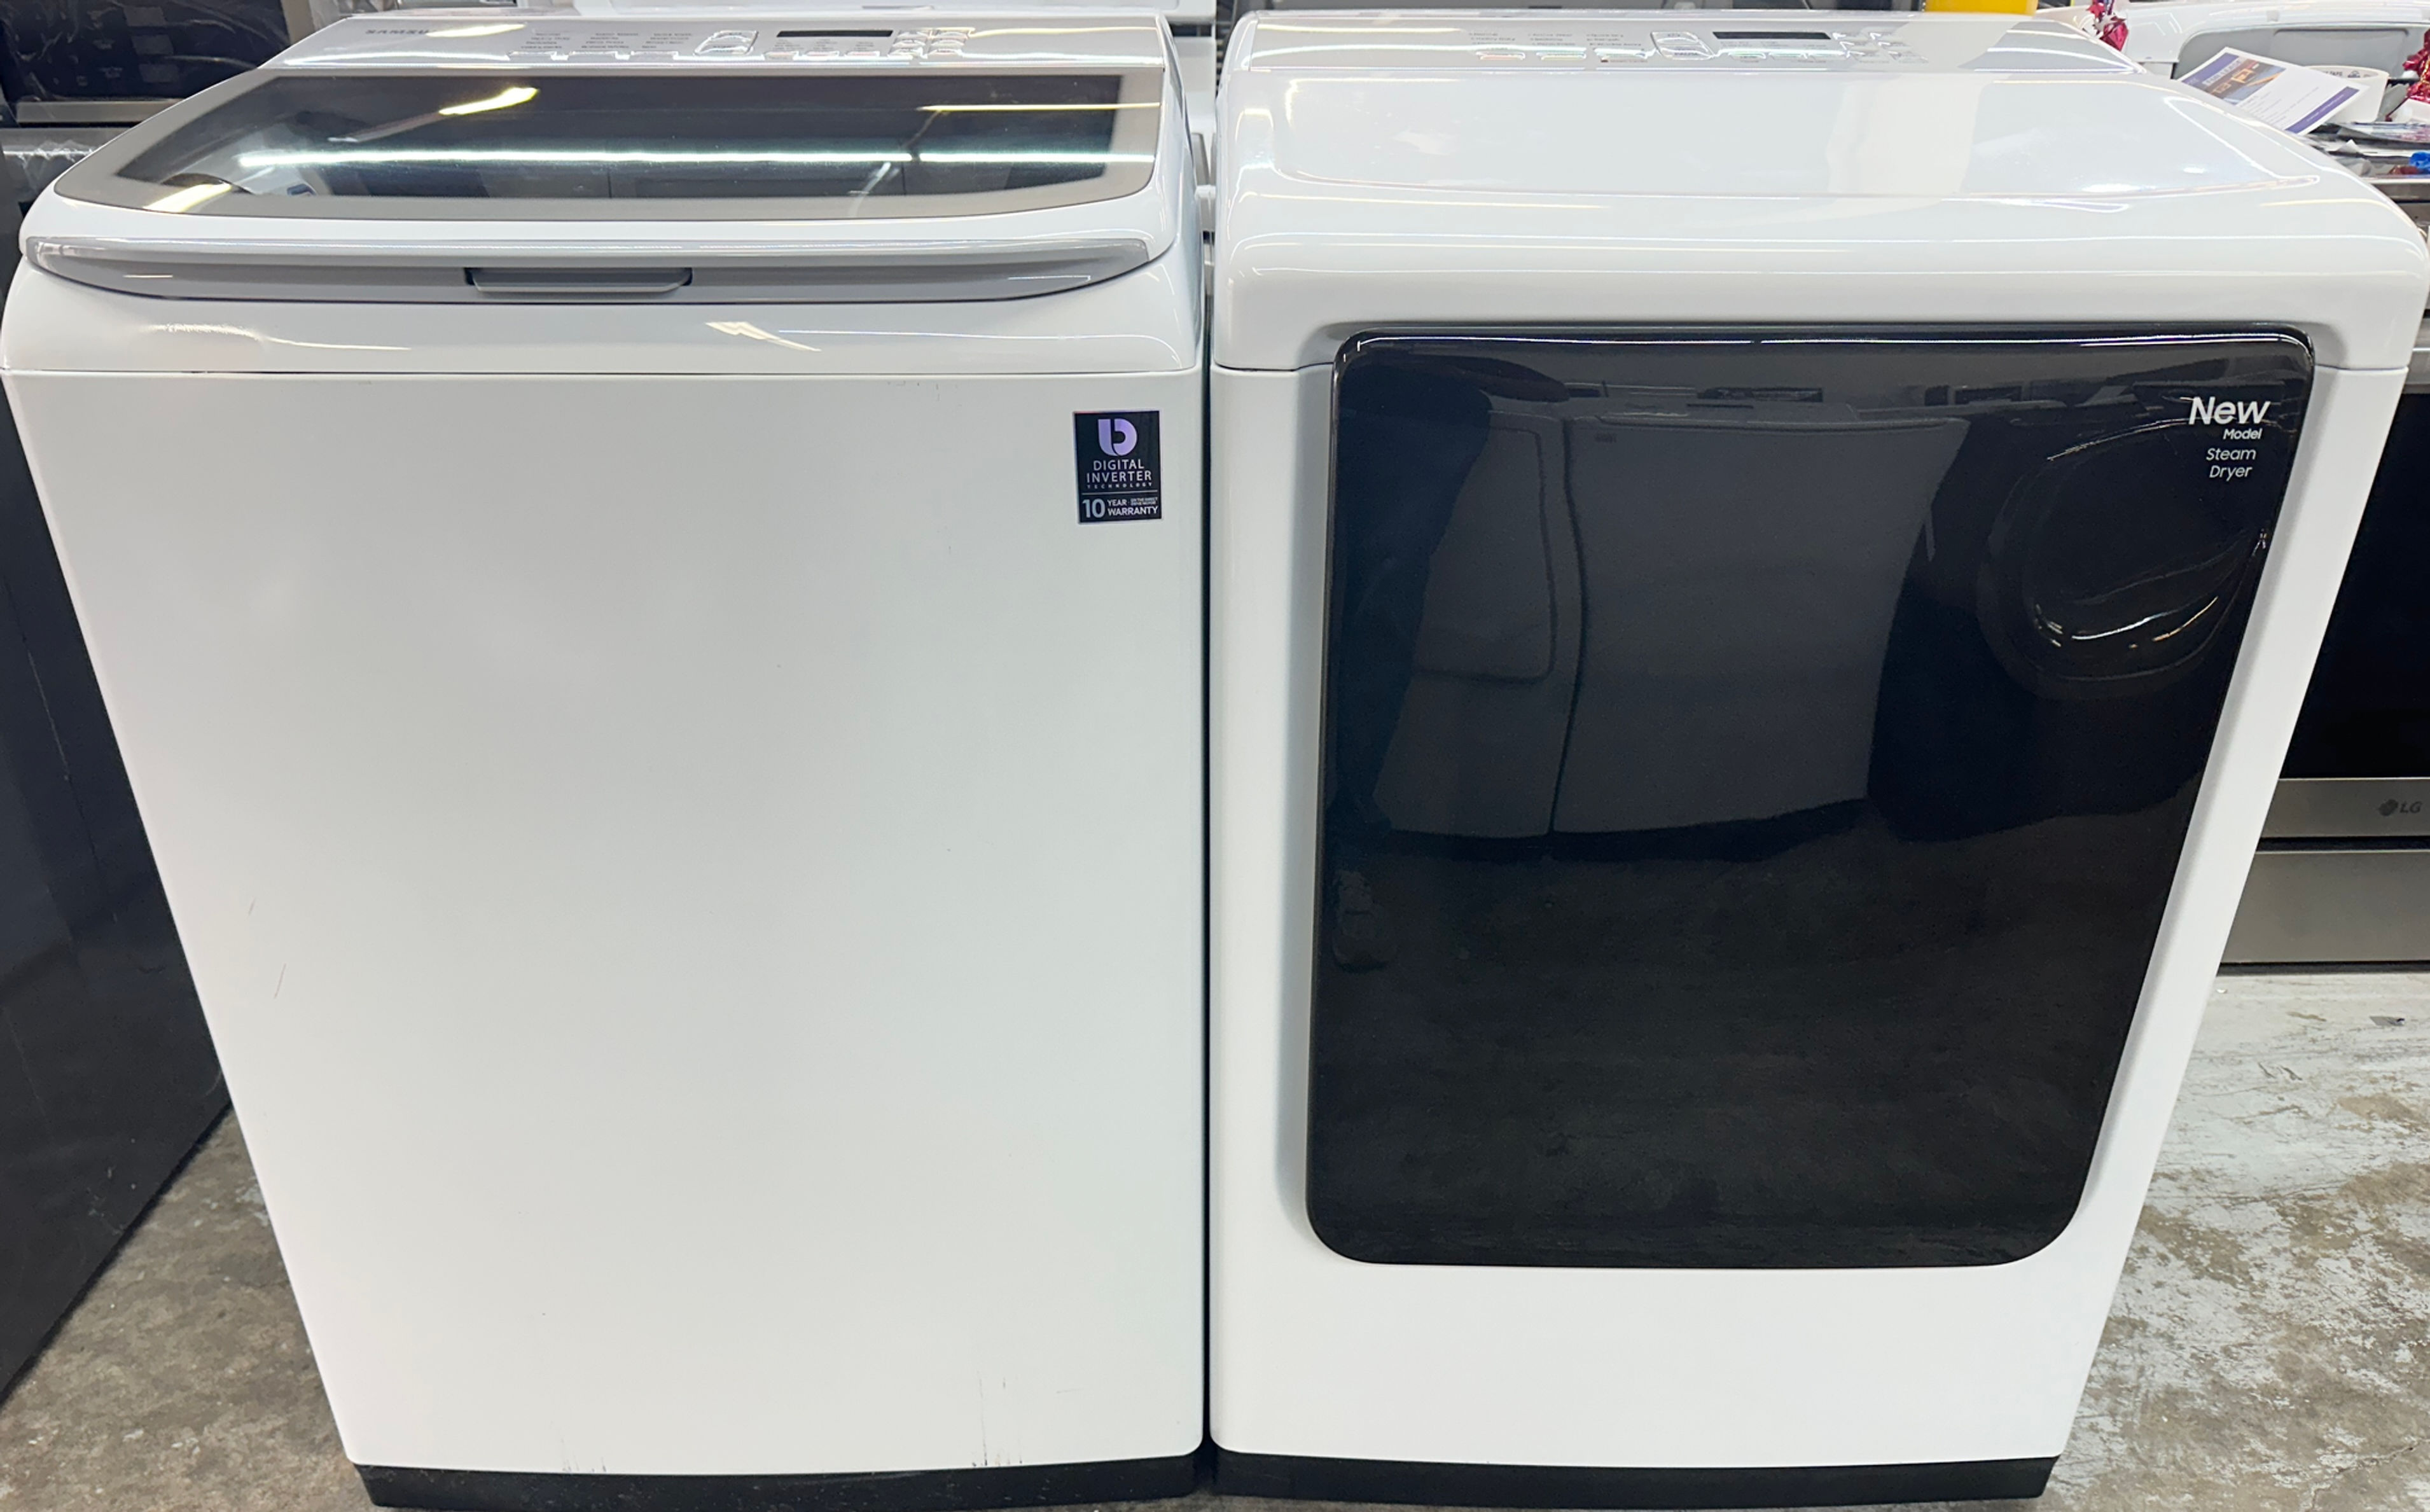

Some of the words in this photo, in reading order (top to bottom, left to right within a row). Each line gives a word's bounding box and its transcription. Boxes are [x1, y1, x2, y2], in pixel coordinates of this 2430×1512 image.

[2188, 396, 2271, 425] New
[2223, 428, 2263, 440] Model
[2205, 448, 2256, 461] Steam
[1094, 459, 1144, 471] DIGITAL
[1087, 470, 1152, 483] INVERTER
[2209, 465, 2253, 482] Dryer
[1082, 498, 1106, 518] 10
[1107, 506, 1158, 516] WARRANTY
[2399, 801, 2422, 814] LG
